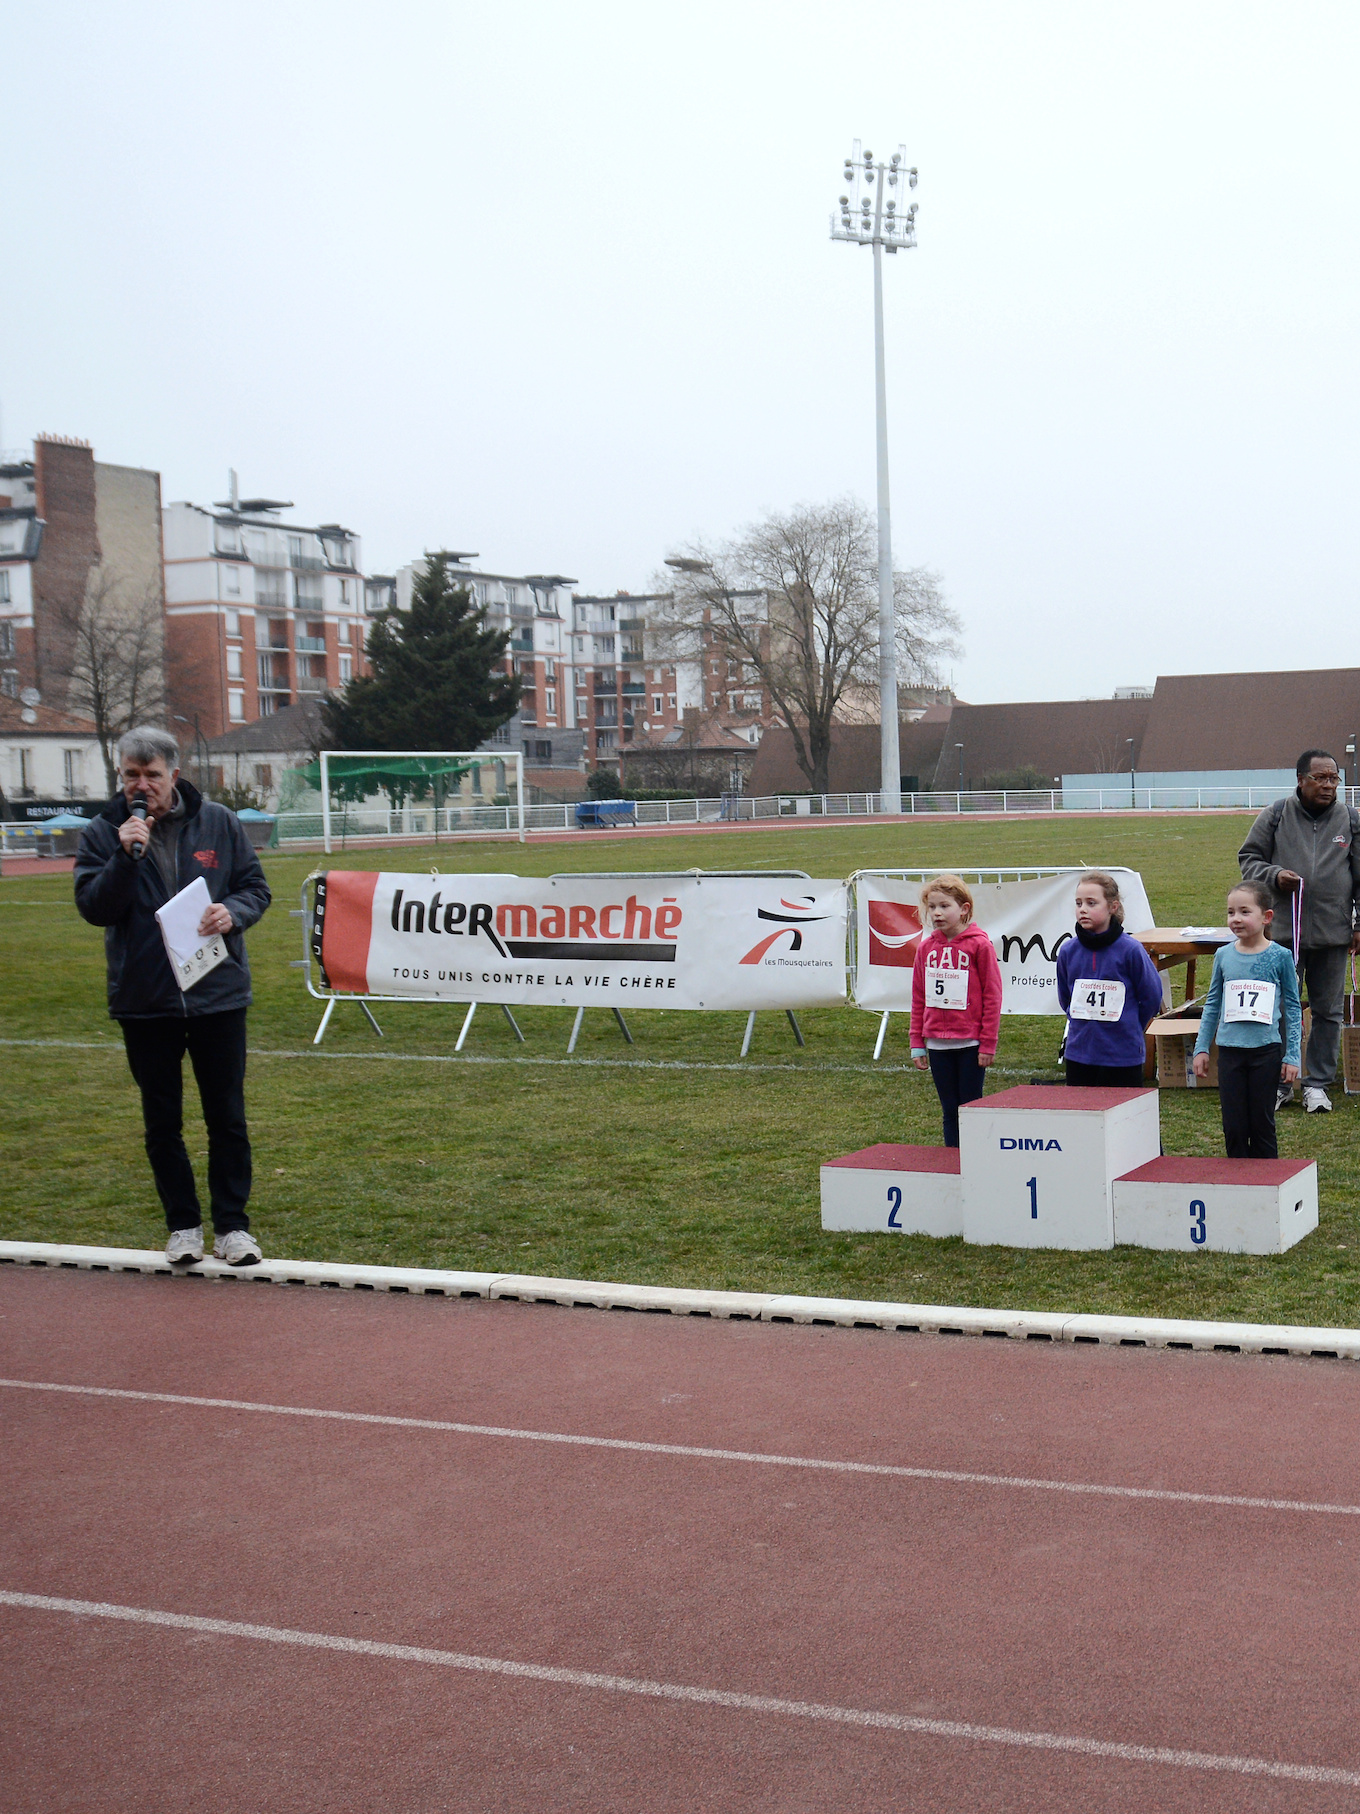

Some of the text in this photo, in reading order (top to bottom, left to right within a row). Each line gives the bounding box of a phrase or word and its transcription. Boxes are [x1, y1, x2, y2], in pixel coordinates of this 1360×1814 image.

[26, 806, 84, 816] RESTAURANT
[391, 888, 683, 959] Intermarché
[777, 958, 833, 968] Mousquetaires
[925, 946, 970, 970] GAP
[392, 968, 677, 989] TOUS UNIS CONTRE LA VIE CHÈRE
[1011, 974, 1057, 988] Protéger
[935, 979, 945, 996] 5
[1086, 990, 1106, 1007] 41
[1237, 990, 1259, 1007] 17
[1000, 1137, 1063, 1152] DIMA
[1026, 1176, 1038, 1220] 1
[886, 1186, 903, 1228] 2
[1189, 1200, 1207, 1244] 3
